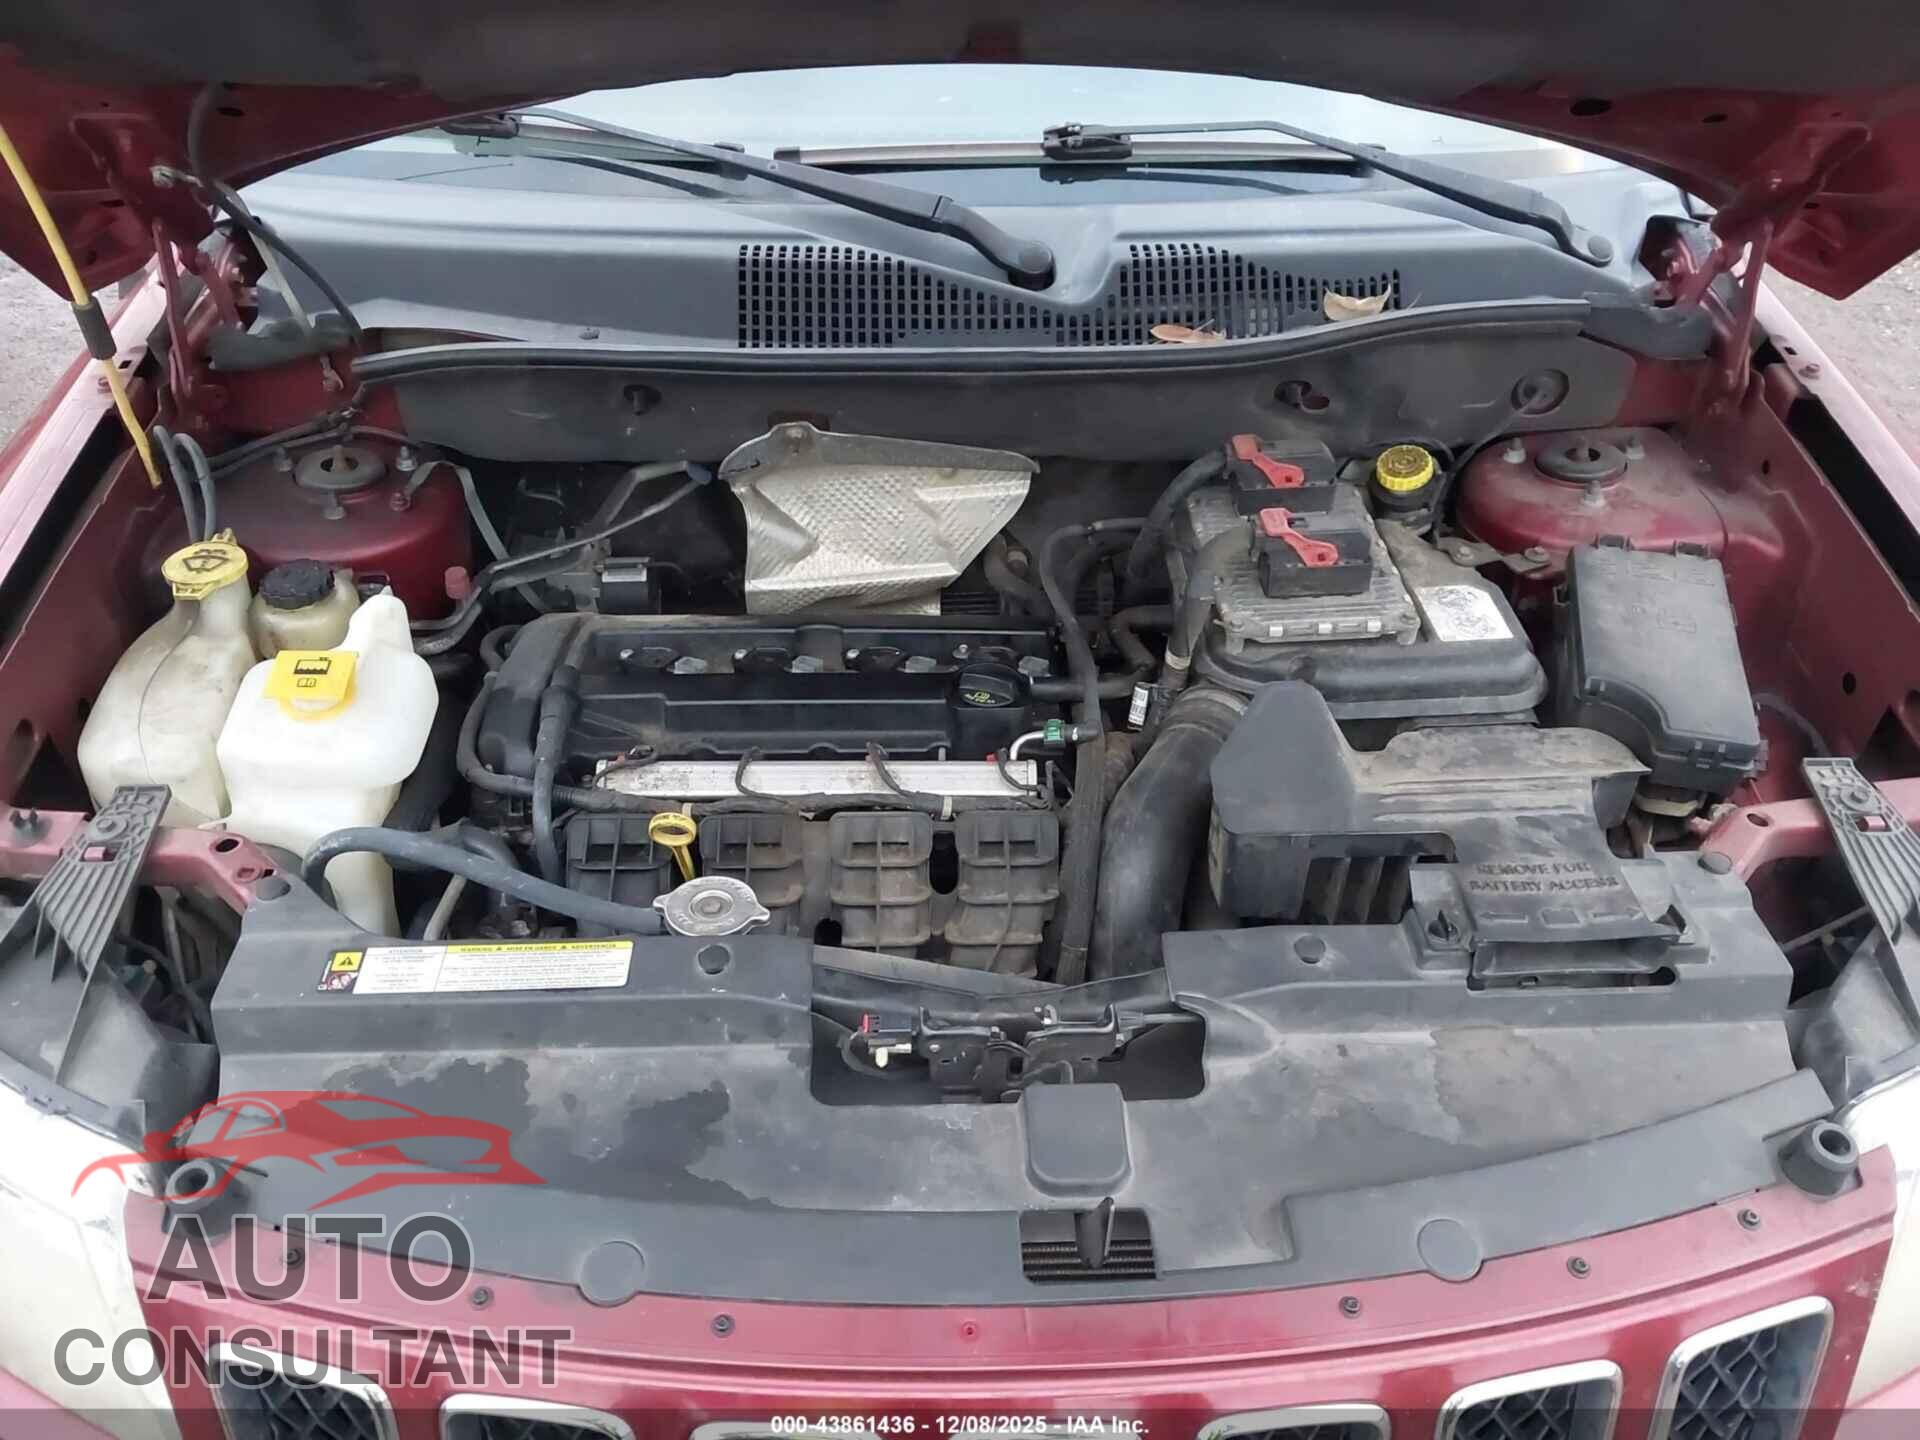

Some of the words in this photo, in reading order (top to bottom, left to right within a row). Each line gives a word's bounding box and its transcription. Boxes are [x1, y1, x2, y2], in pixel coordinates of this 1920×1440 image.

[1477, 863, 1549, 875] REMOVE
[1552, 862, 1592, 875] FOR
[1470, 880, 1542, 892] BATTERY
[1550, 876, 1619, 892] ACCESS
